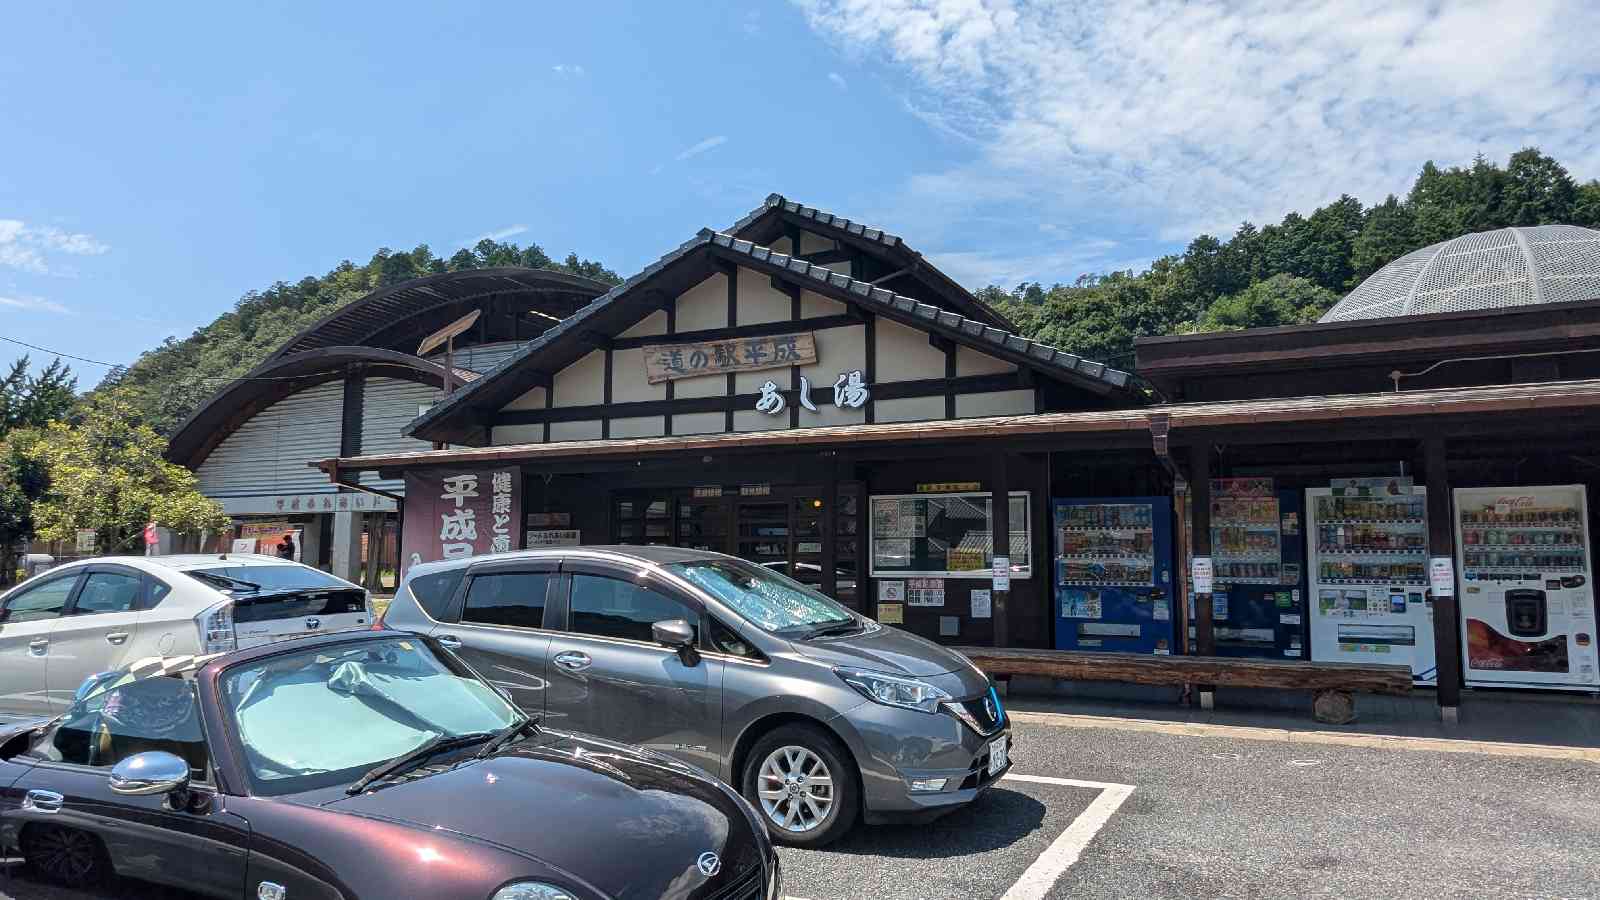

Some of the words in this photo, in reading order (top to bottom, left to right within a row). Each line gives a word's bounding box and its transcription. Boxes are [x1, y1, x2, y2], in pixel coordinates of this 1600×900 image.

[660, 336, 801, 374] 道の駅平成
[755, 370, 870, 414] あし湯
